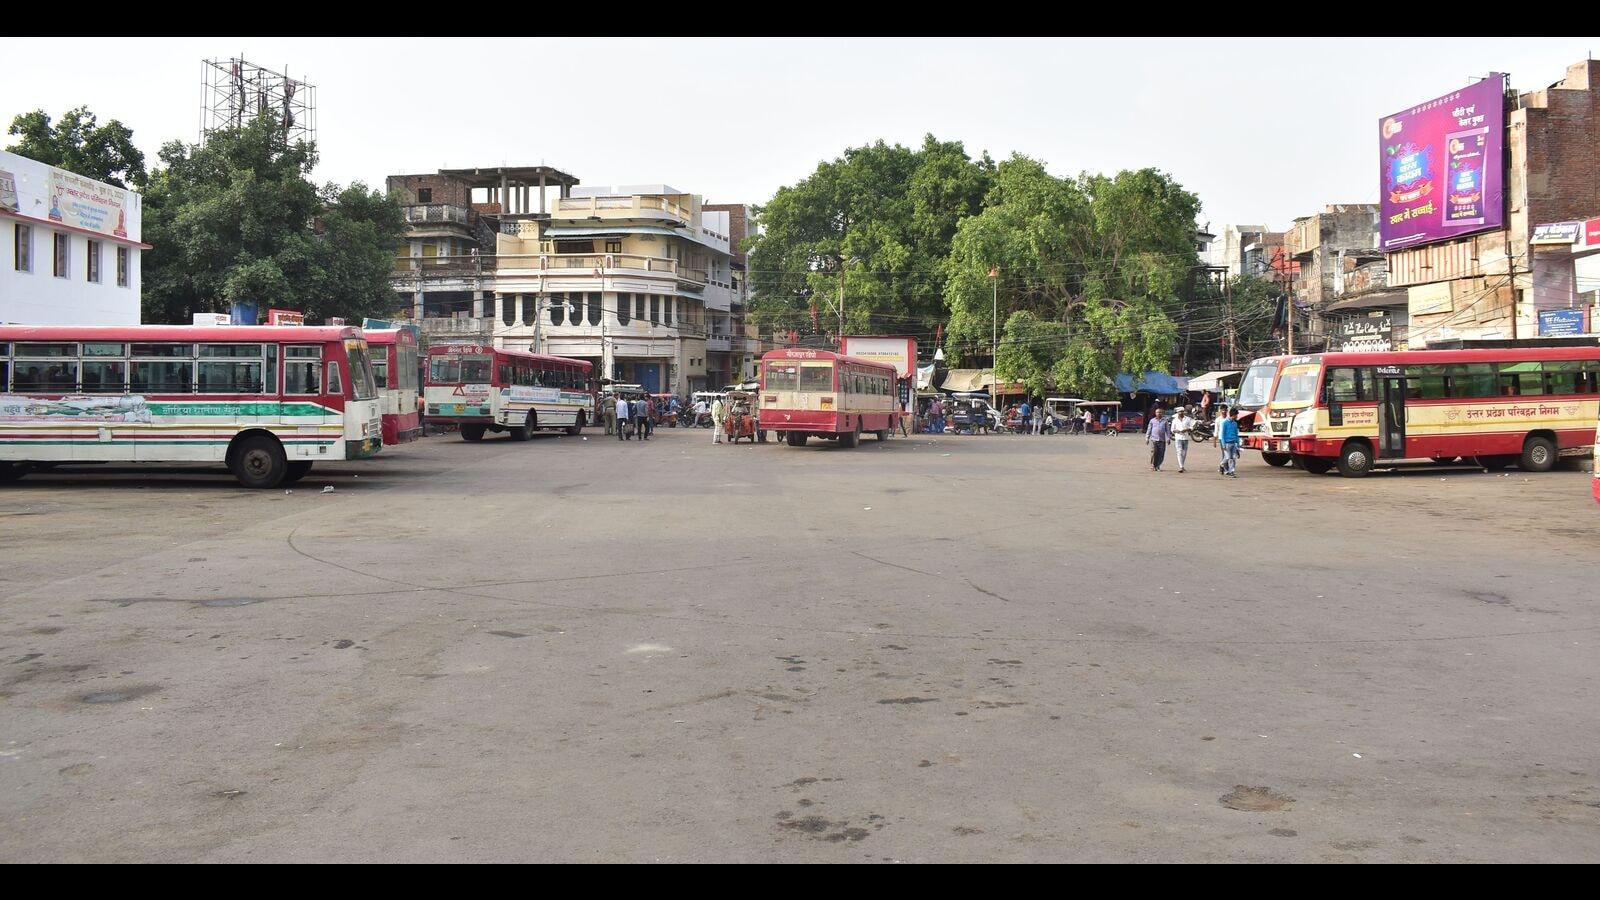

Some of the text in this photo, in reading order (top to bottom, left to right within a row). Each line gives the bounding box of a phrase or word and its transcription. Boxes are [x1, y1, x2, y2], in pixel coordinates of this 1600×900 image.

[1390, 213, 1403, 225] स्वाद
[1466, 404, 1560, 419] उत्तर प्रदेश परिवहन निगम
